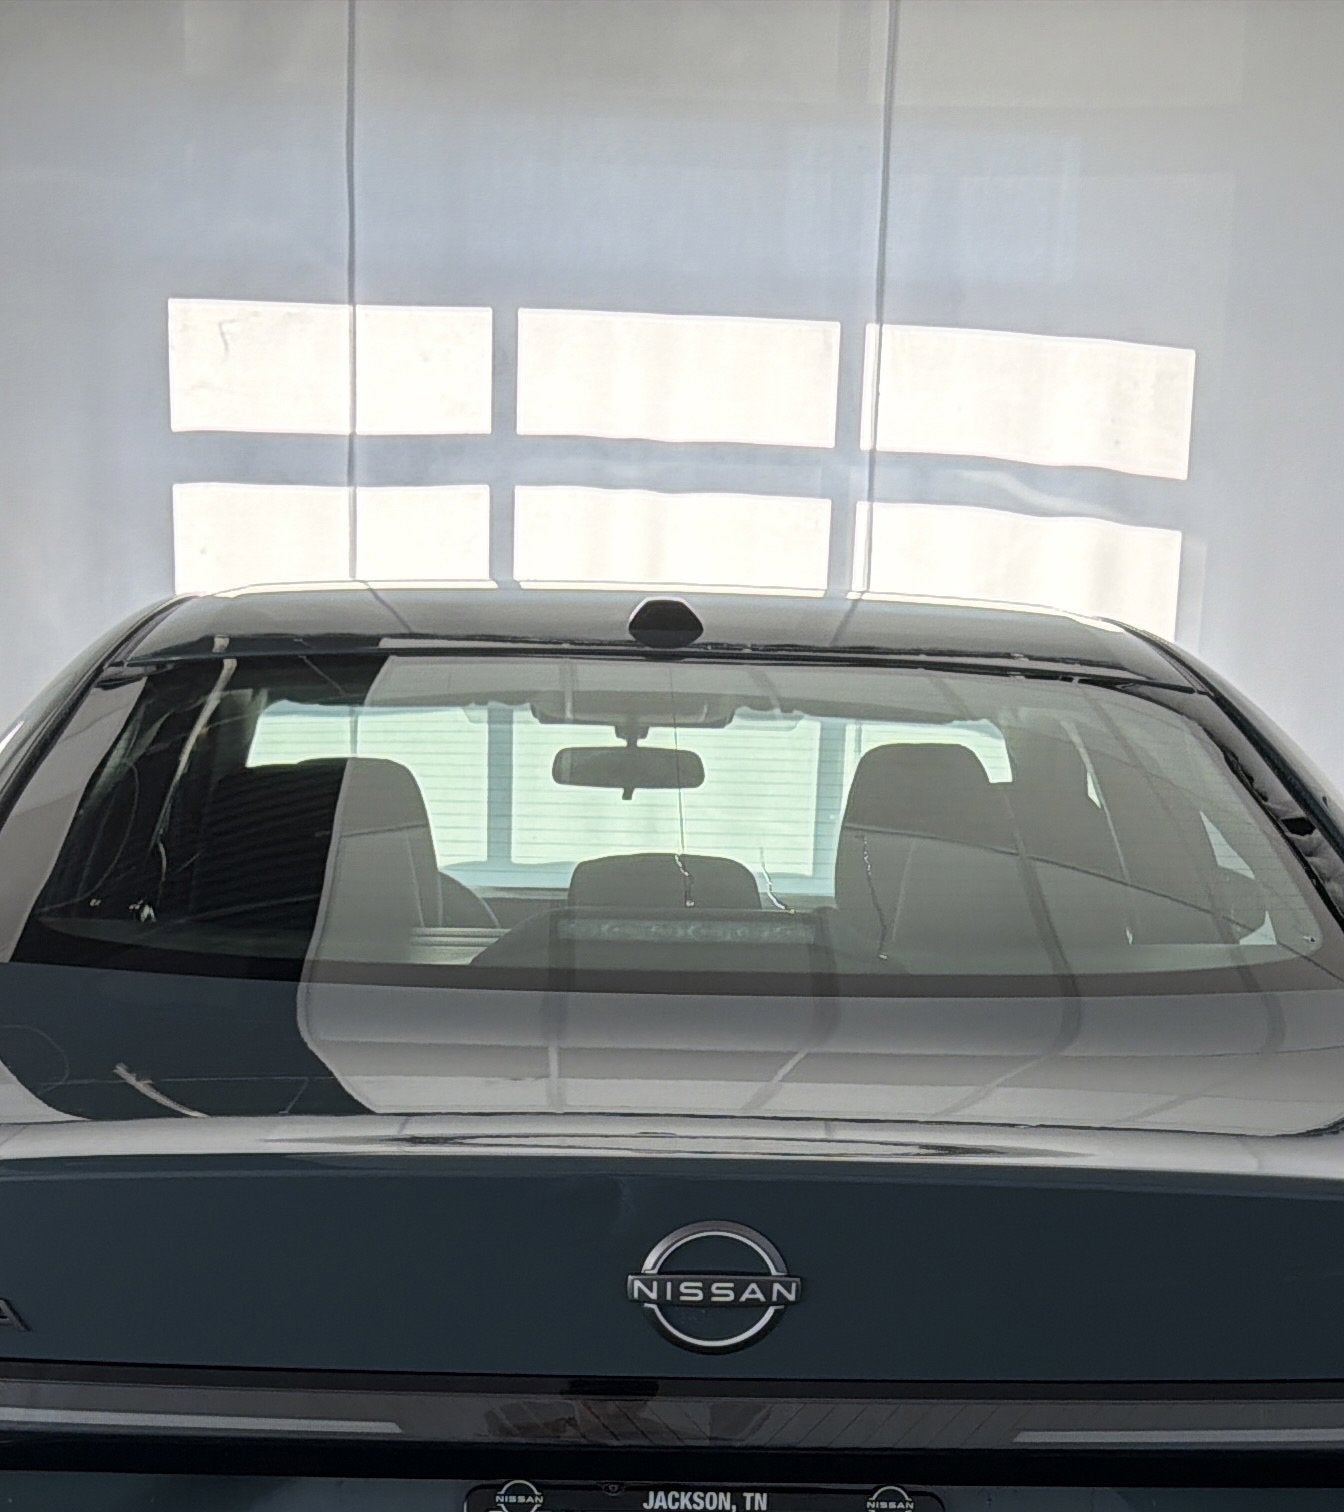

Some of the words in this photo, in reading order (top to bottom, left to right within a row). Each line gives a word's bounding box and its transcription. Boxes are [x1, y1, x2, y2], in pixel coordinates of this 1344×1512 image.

[633, 1279, 797, 1302] NISSAN
[495, 1495, 544, 1504] NISSAN
[742, 1492, 768, 1511] TN
[866, 1501, 914, 1510] NISSAN
